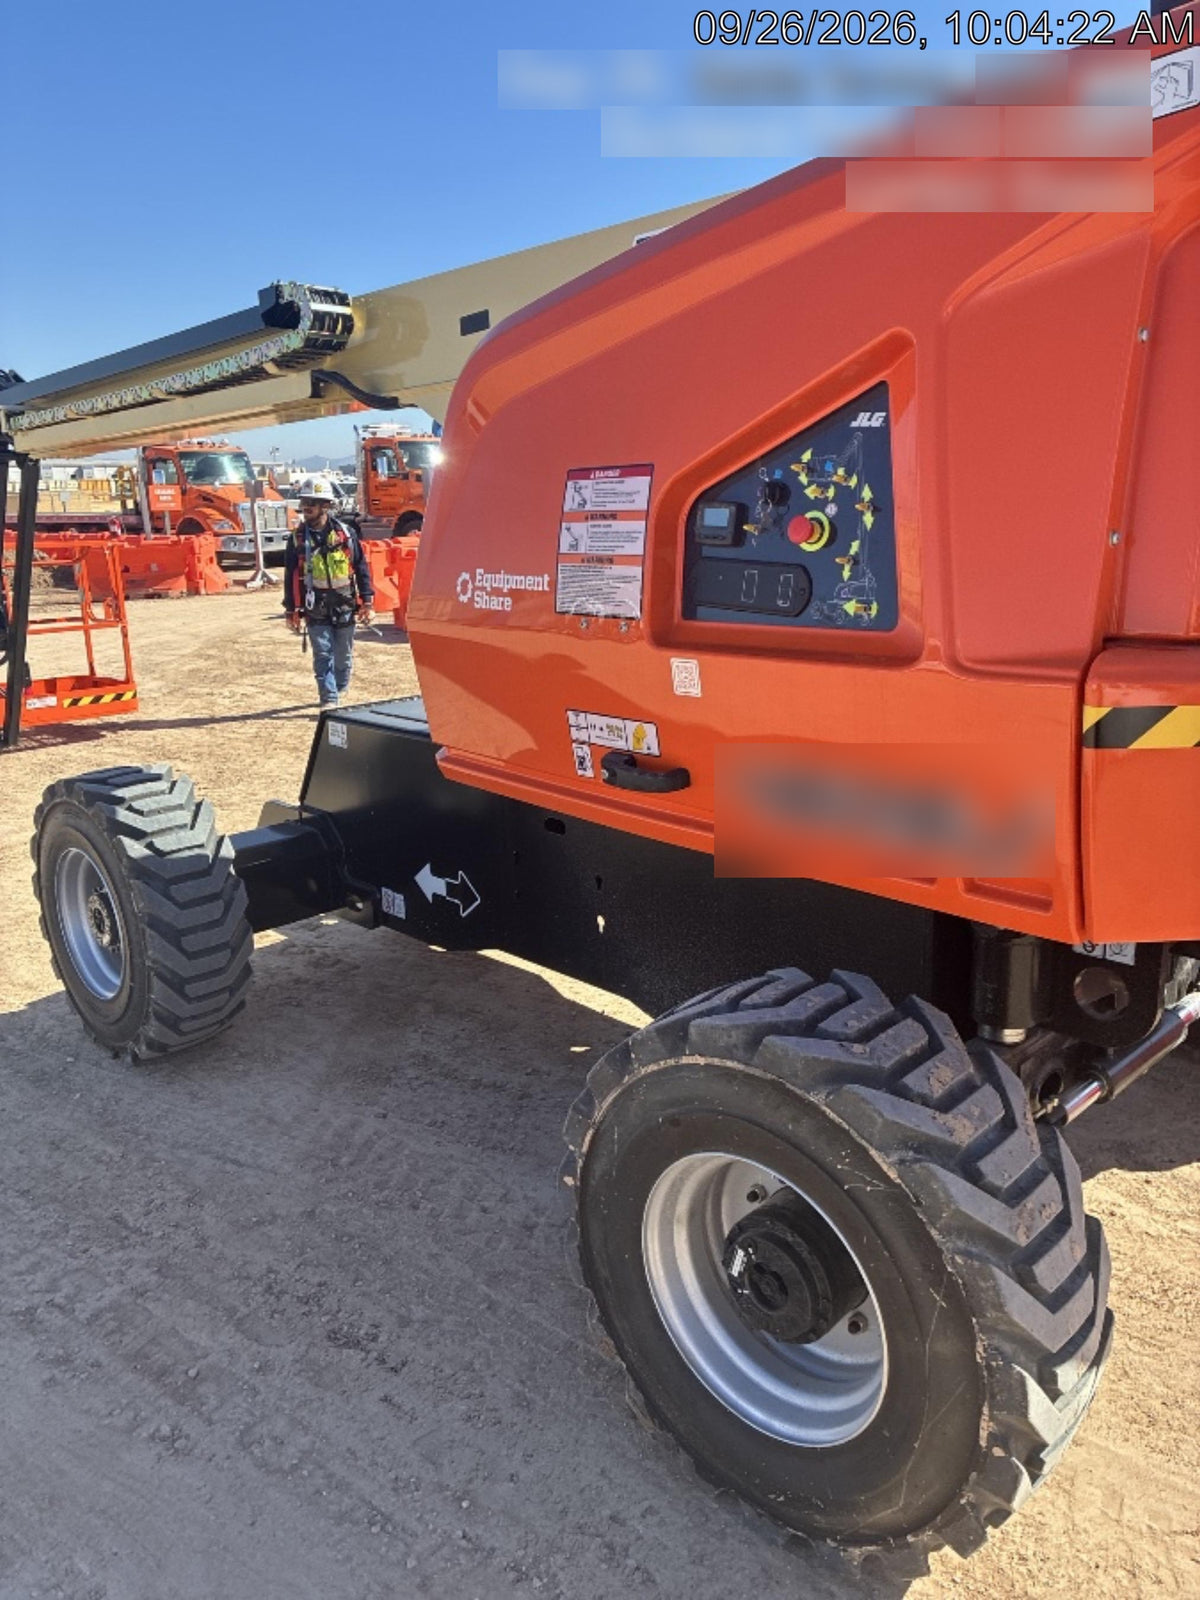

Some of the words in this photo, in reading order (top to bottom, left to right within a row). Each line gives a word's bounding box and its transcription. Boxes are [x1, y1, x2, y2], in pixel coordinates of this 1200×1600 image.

[849, 411, 887, 428] JLG
[474, 568, 550, 592] Equipment
[474, 590, 513, 611] Share
